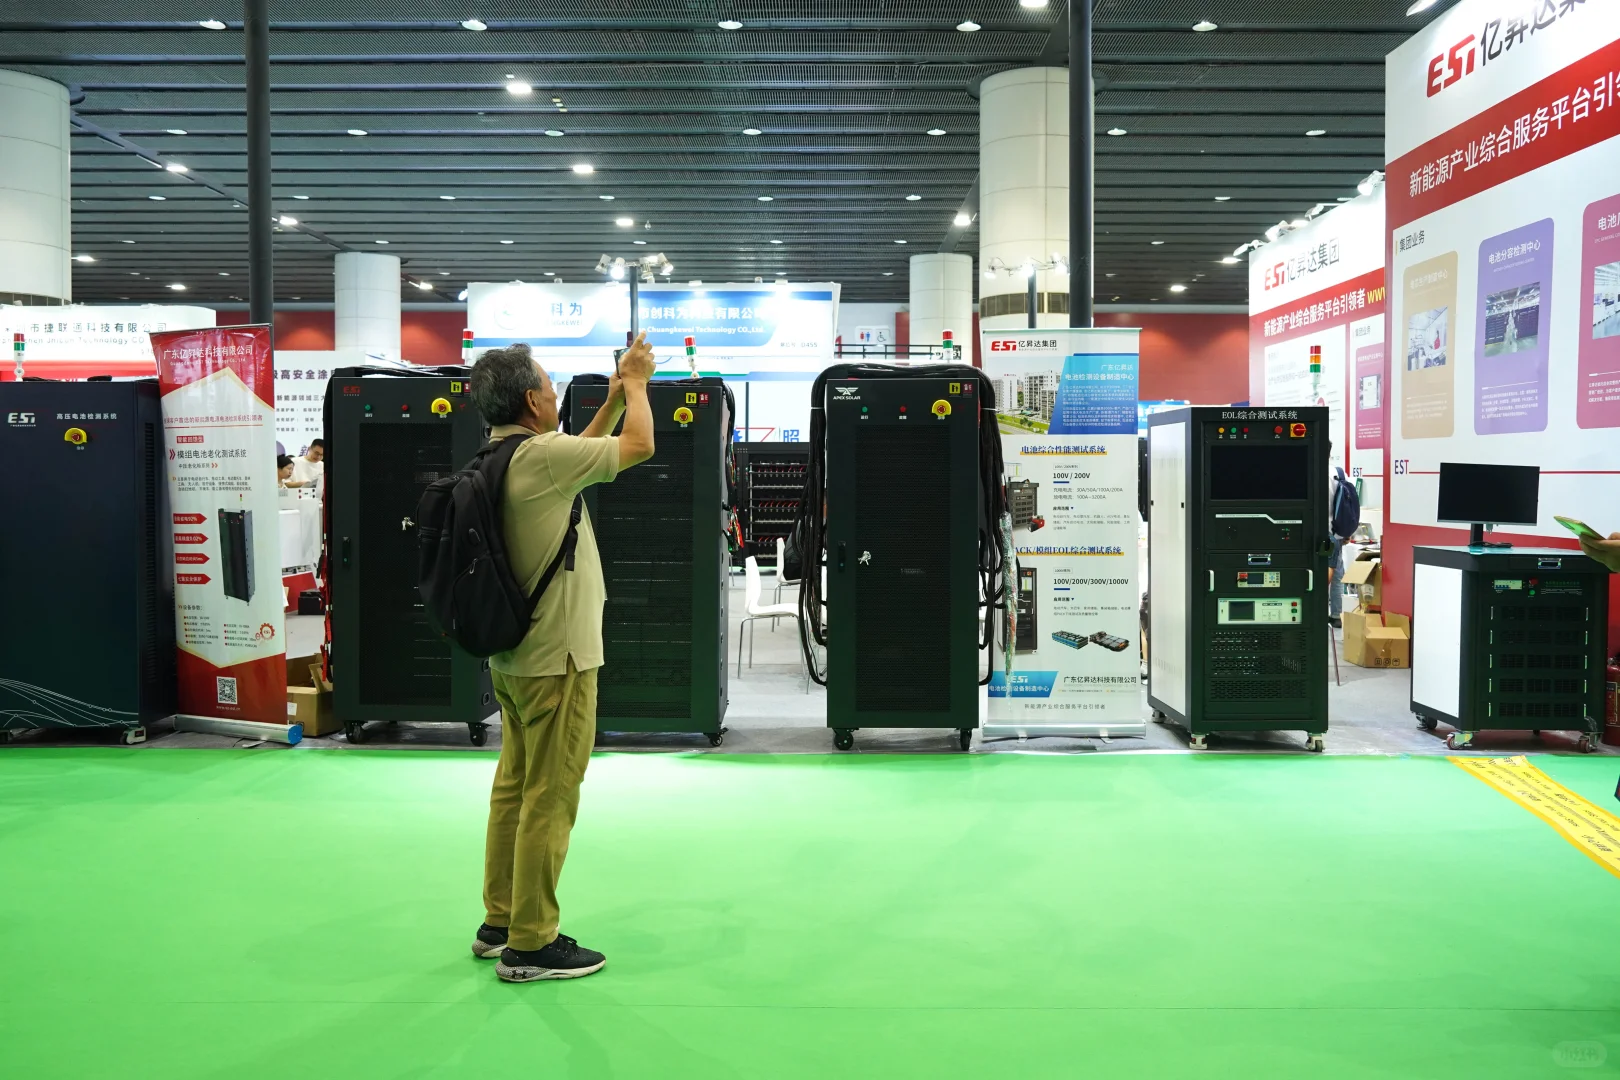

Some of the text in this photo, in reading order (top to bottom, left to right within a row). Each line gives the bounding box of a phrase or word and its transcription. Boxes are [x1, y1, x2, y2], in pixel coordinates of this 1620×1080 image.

[1400, 229, 1425, 253] 集团业务
[1488, 239, 1541, 265] 电池分容检测中心
[1286, 237, 1340, 281] 亿昇达集团
[1264, 287, 1366, 338] 新能源产业综合服务平台引领者
[1018, 340, 1057, 348] 亿昇达集团
[163, 345, 253, 360] 广东亿昇达科技有限公司
[274, 369, 335, 380] 高安全涂
[1065, 373, 1134, 381] 电池检测设备制造中心
[1222, 410, 1298, 420] EOL综合测试系统
[177, 449, 247, 459] 模组电池老化测试系统
[1021, 445, 1106, 455] 电池综合性能测试系统
[1352, 467, 1363, 478] EST
[1394, 459, 1410, 475] EST
[1014, 545, 1122, 556] ACK/模组EOL综合测试系统
[1063, 676, 1137, 684] 广东亿昇达科技有限公司
